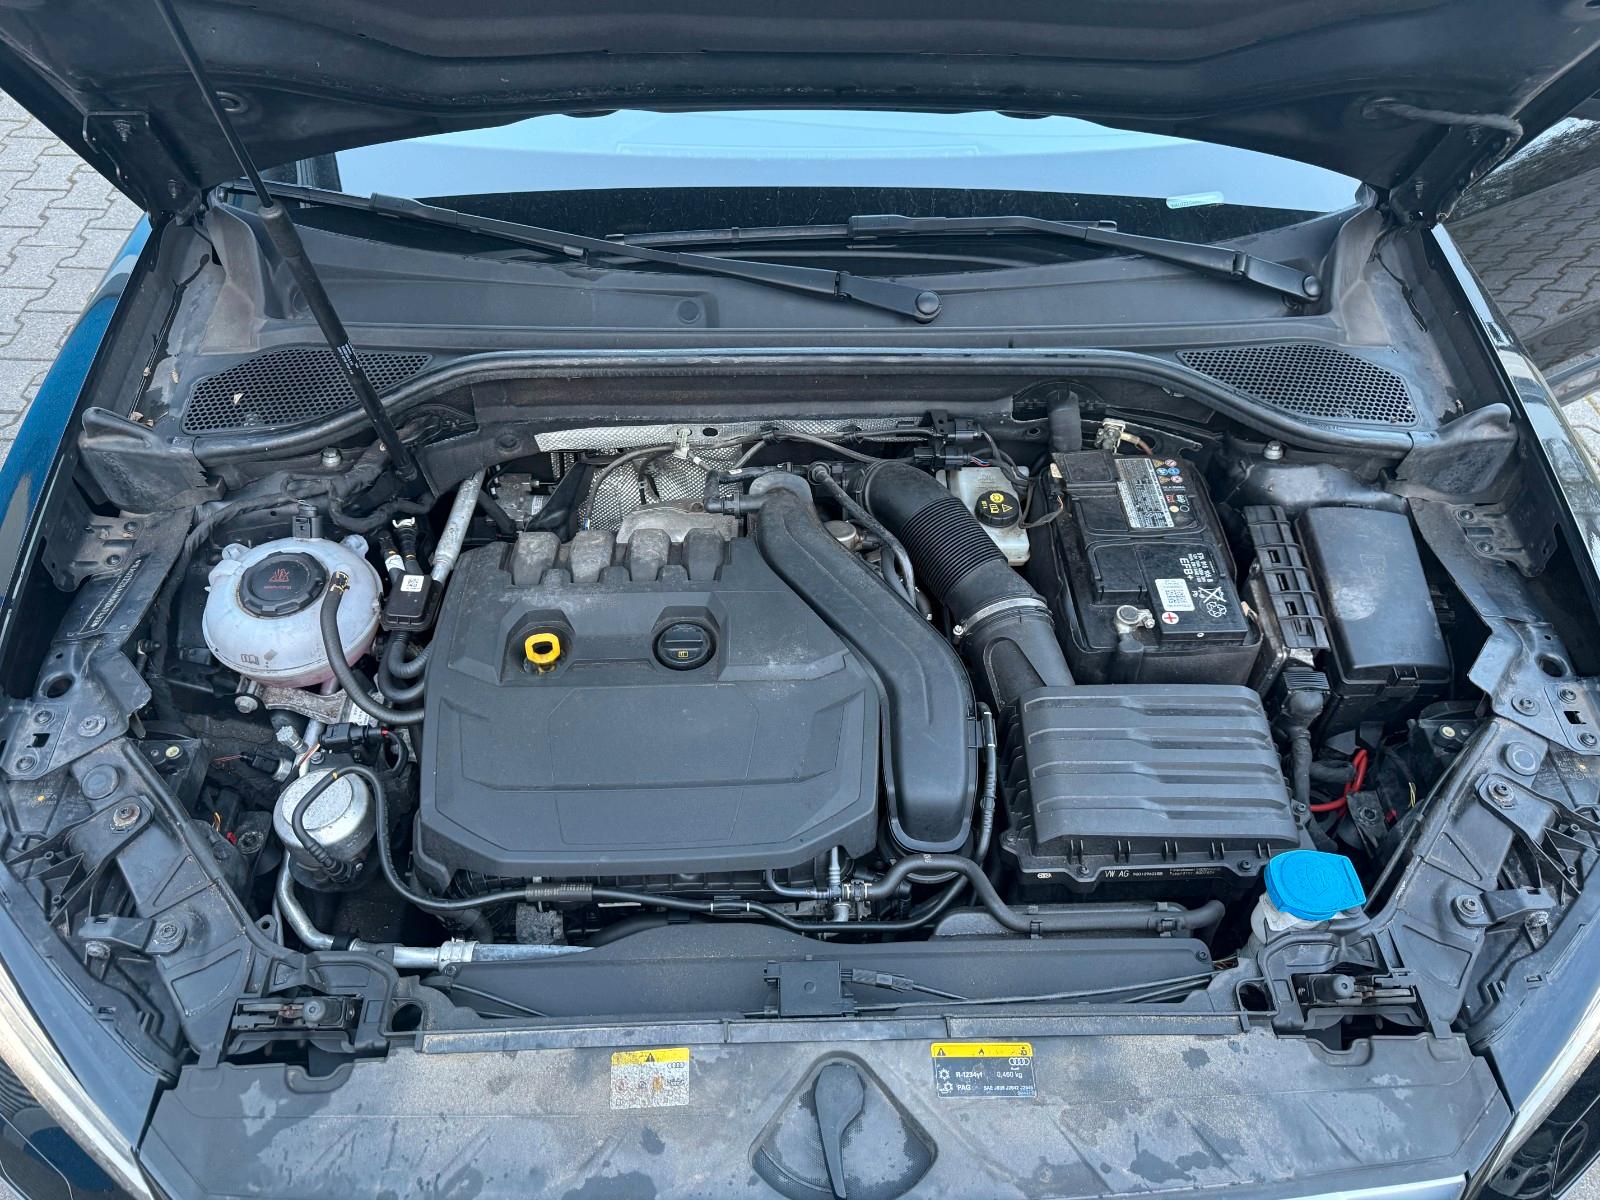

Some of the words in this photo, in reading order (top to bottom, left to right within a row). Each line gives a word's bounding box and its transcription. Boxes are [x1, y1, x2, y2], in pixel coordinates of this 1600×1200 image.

[1179, 557, 1194, 580] EFB+
[1104, 869, 1115, 878] VW
[1119, 869, 1130, 878] AG
[955, 1071, 983, 1080] R-1234yf
[1014, 1071, 1023, 1079] kg
